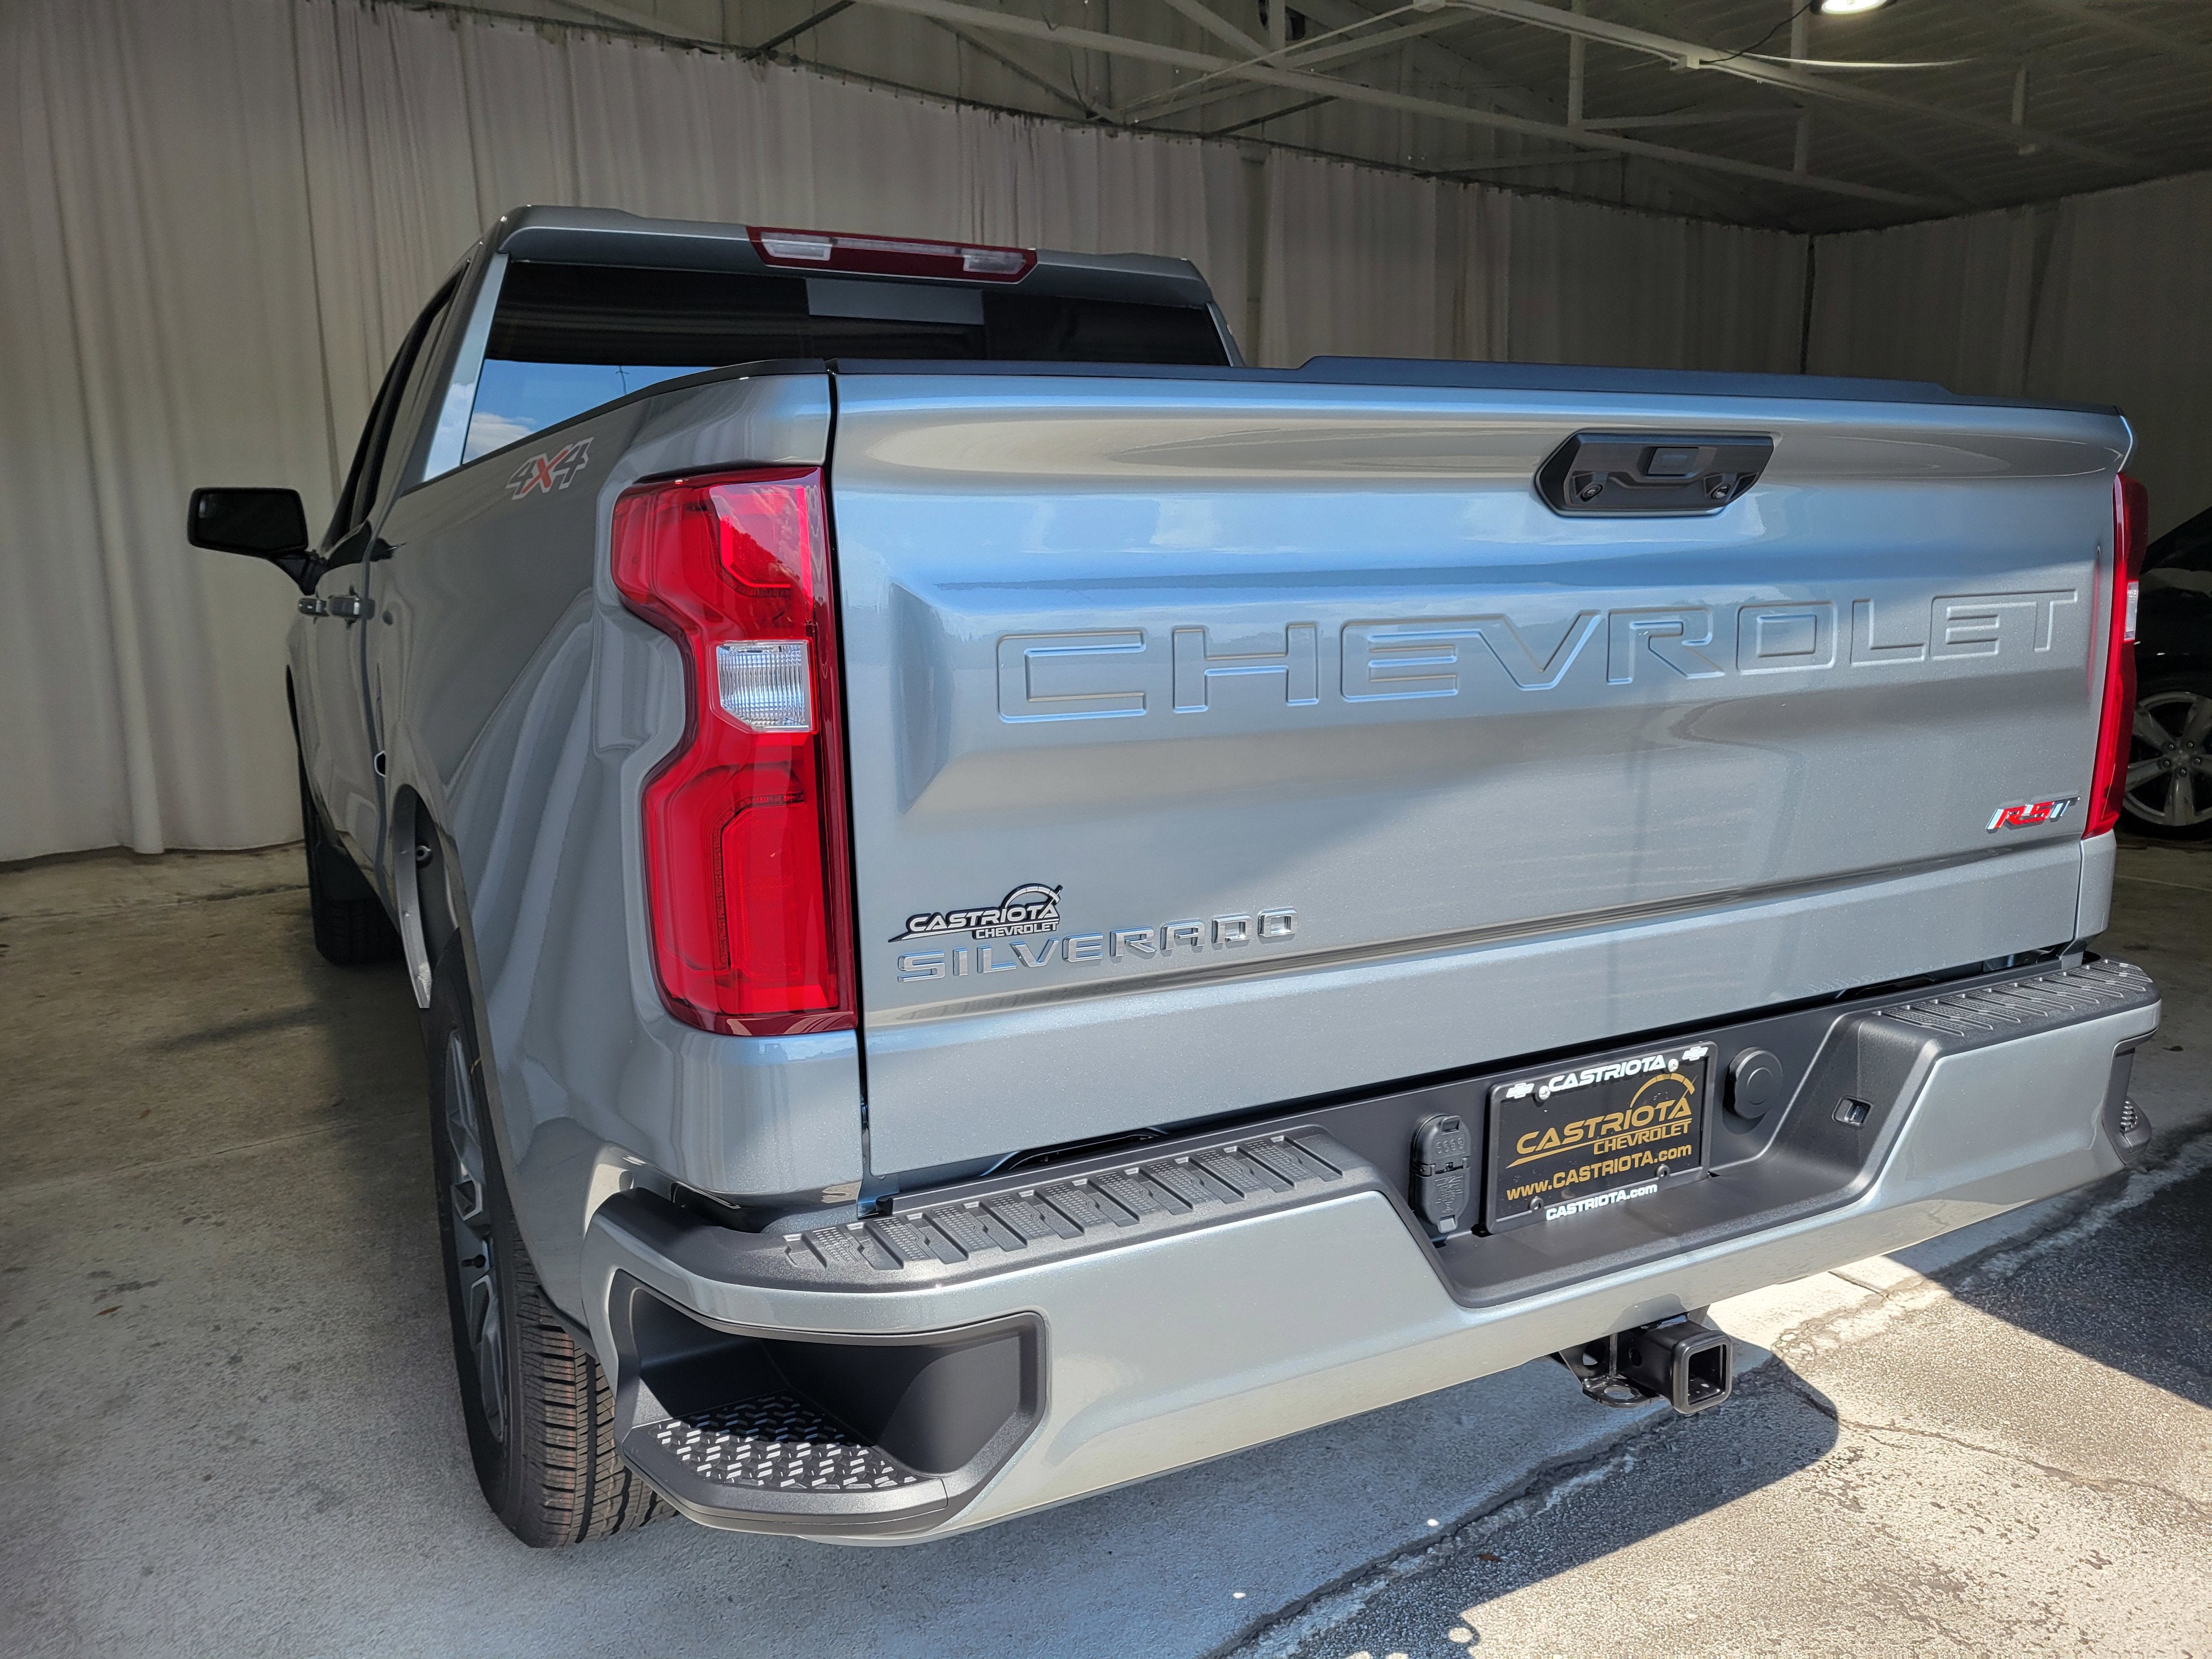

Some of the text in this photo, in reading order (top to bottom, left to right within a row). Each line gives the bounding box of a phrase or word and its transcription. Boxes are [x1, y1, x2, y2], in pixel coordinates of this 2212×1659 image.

[997, 589, 2079, 723] CHEVROLET
[1986, 797, 2081, 830] RST
[909, 902, 1059, 932] CASTRIOTA
[975, 921, 1059, 940] CHEVROLET
[898, 907, 1299, 983] SILVERADO
[1548, 1054, 1666, 1093] CASTRIOTA
[1516, 1097, 1692, 1155] CASTRIOTA
[1593, 1121, 1691, 1155] CHEVROLET
[1506, 1144, 1692, 1201] www.CASTRIOTA.com
[1545, 1183, 1658, 1221] CASTRIOTA.com
